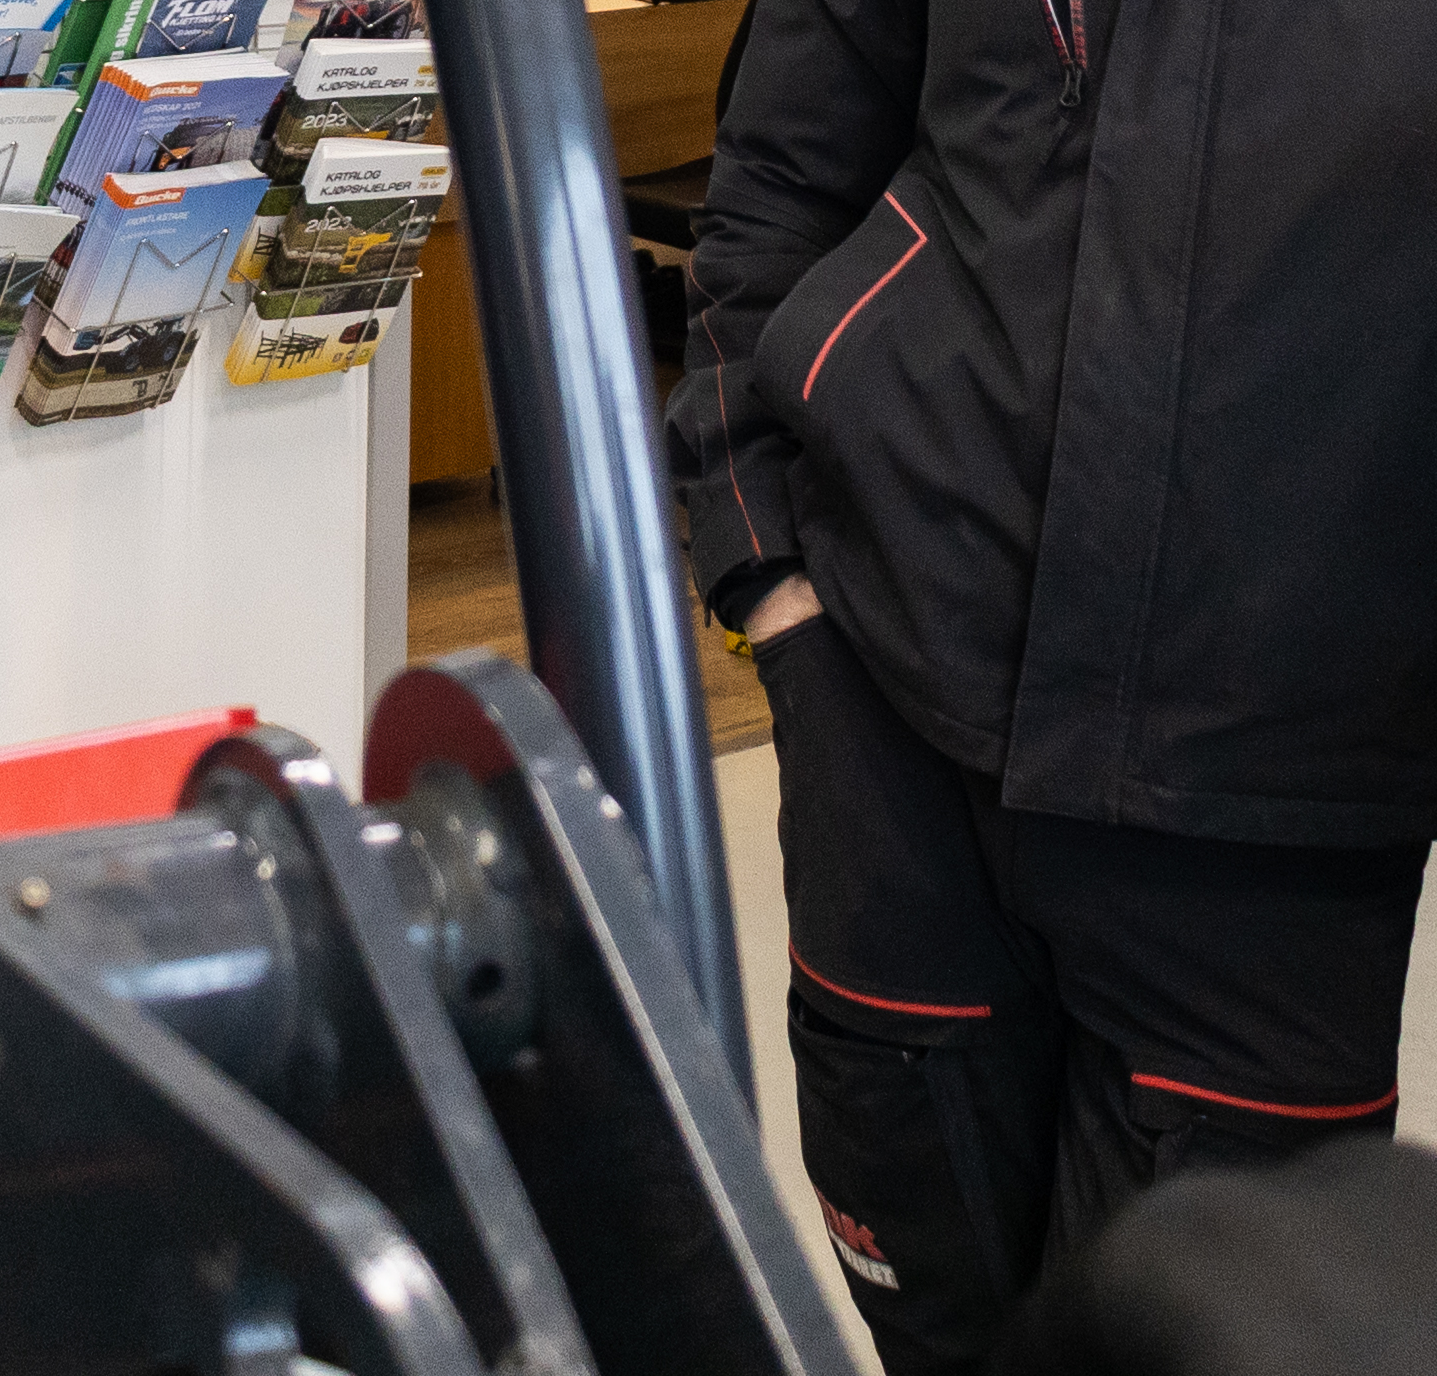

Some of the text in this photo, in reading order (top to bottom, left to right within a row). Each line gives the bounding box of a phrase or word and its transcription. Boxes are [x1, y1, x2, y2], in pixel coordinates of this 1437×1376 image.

[322, 66, 379, 79] KATALOG
[316, 78, 410, 92] KJØPSHJELPER
[301, 112, 348, 130] 2023
[325, 169, 382, 183] KATALOG
[319, 180, 413, 196] KJØPSHJELPER
